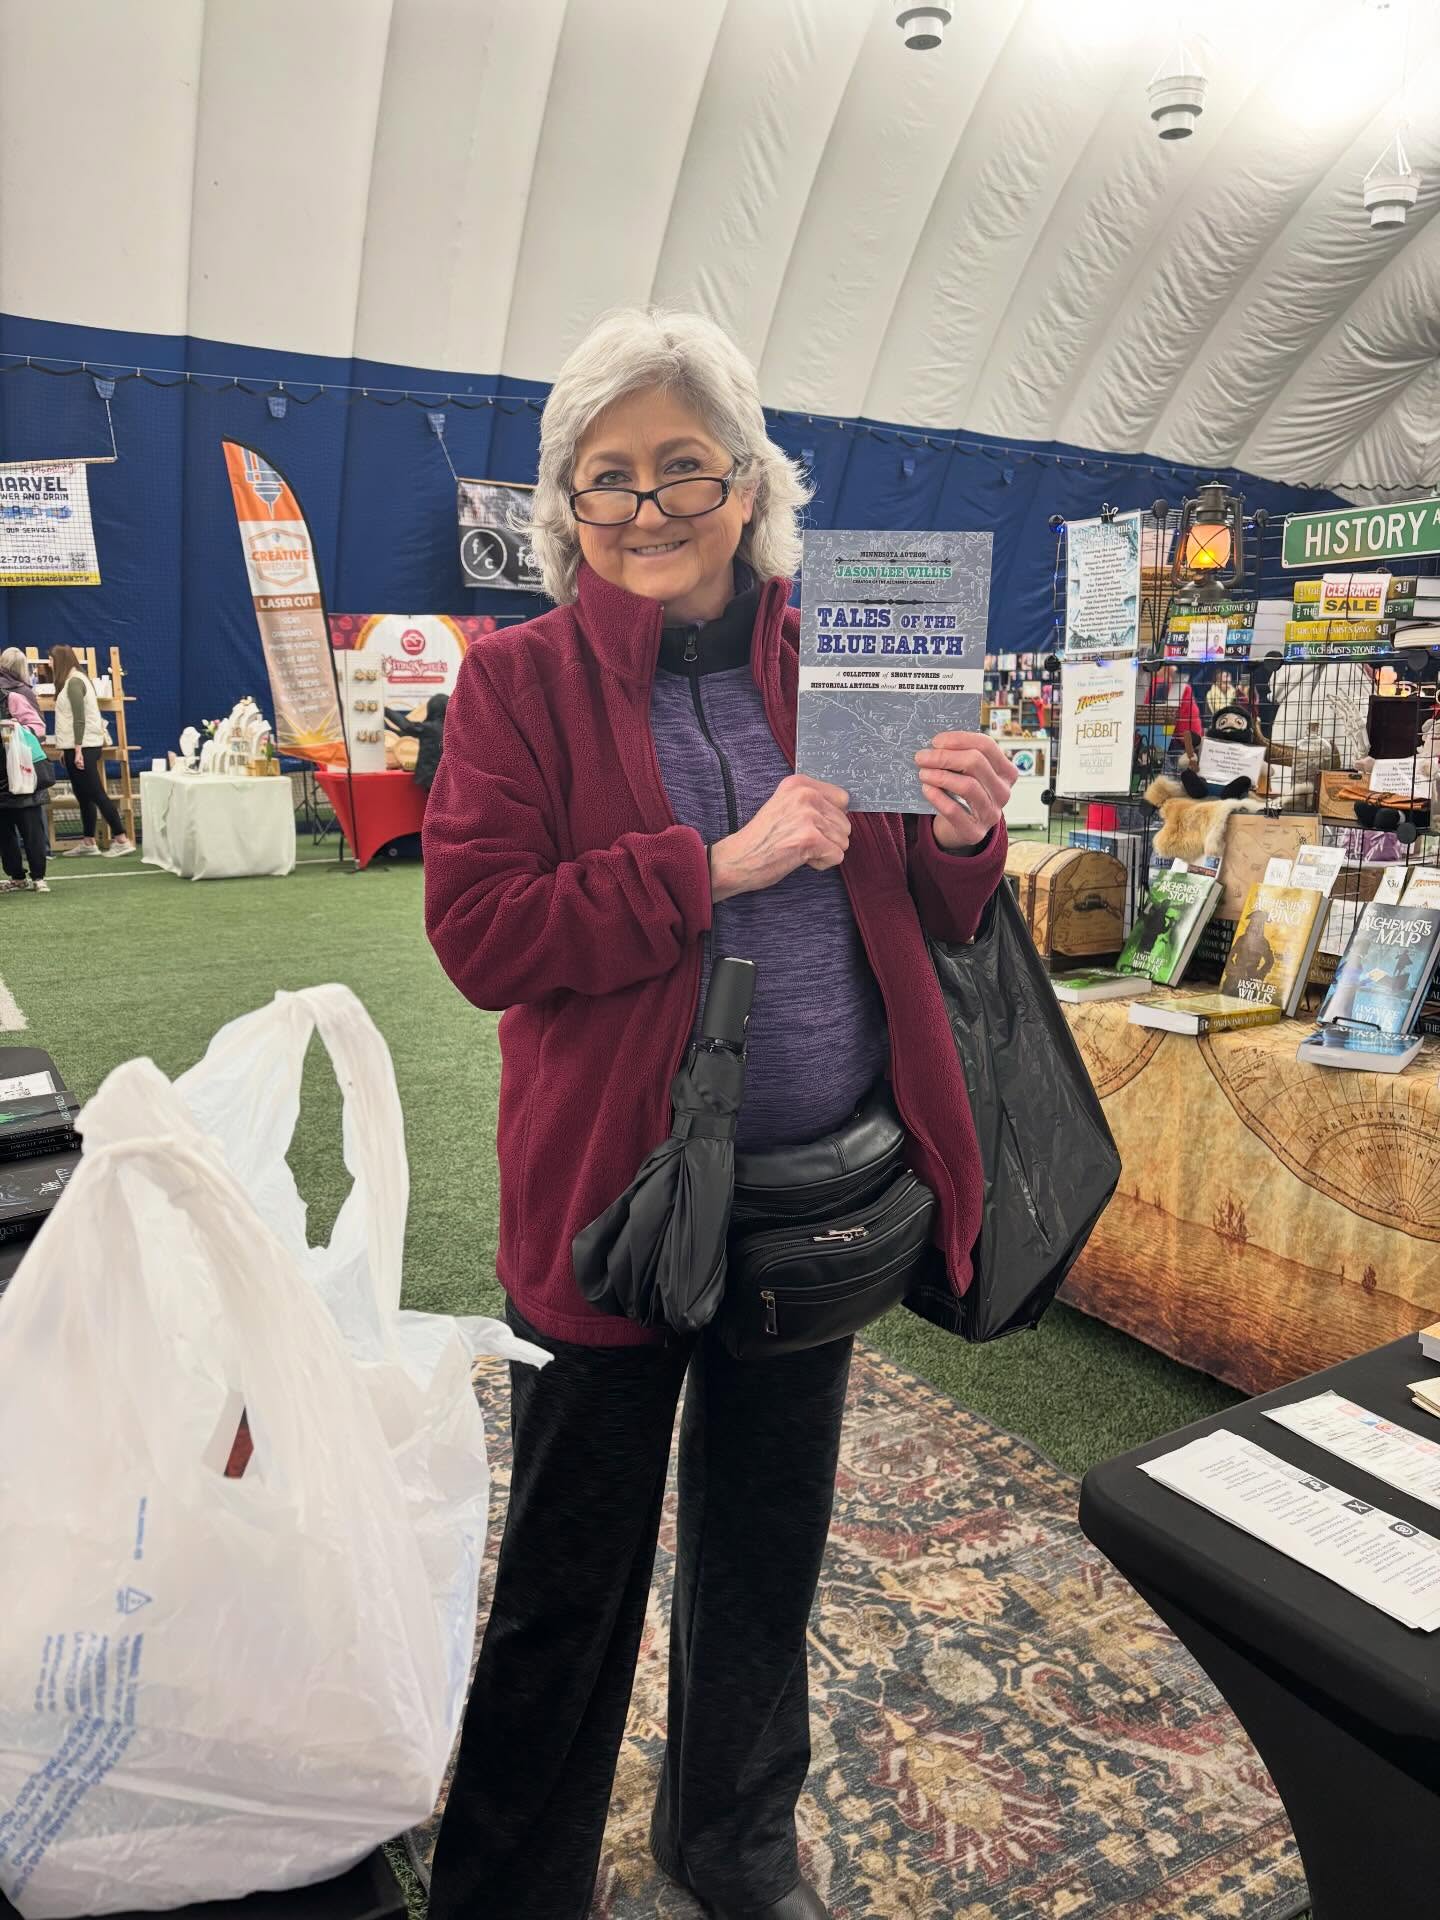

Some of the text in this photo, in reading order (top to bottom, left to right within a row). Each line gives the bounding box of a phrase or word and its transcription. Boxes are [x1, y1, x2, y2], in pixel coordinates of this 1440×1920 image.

[22, 493, 41, 501] AND
[43, 493, 69, 501] DRAIN
[1304, 509, 1428, 557] HISTORY
[0, 555, 61, 563] 2-703-6704
[252, 549, 309, 561] CREATIVE
[836, 566, 952, 578] JASON LEE WILLIS
[1326, 583, 1381, 597] CLEARANCE
[260, 597, 313, 609] LASER CUT
[1325, 599, 1378, 611] SALE
[817, 607, 956, 629] TALES OF THE
[1172, 634, 1184, 642] THE
[817, 634, 964, 655] BLUE EARTH
[1293, 645, 1376, 655] THE ALCHEMIST'S STONE
[939, 683, 964, 691] COUNTY
[1075, 721, 1122, 745] HOBBIT
[1168, 891, 1195, 904] STONE
[1375, 929, 1422, 947] MAP
[1237, 979, 1278, 994] JASON LEE
[1238, 988, 1273, 1004] WILLIS
